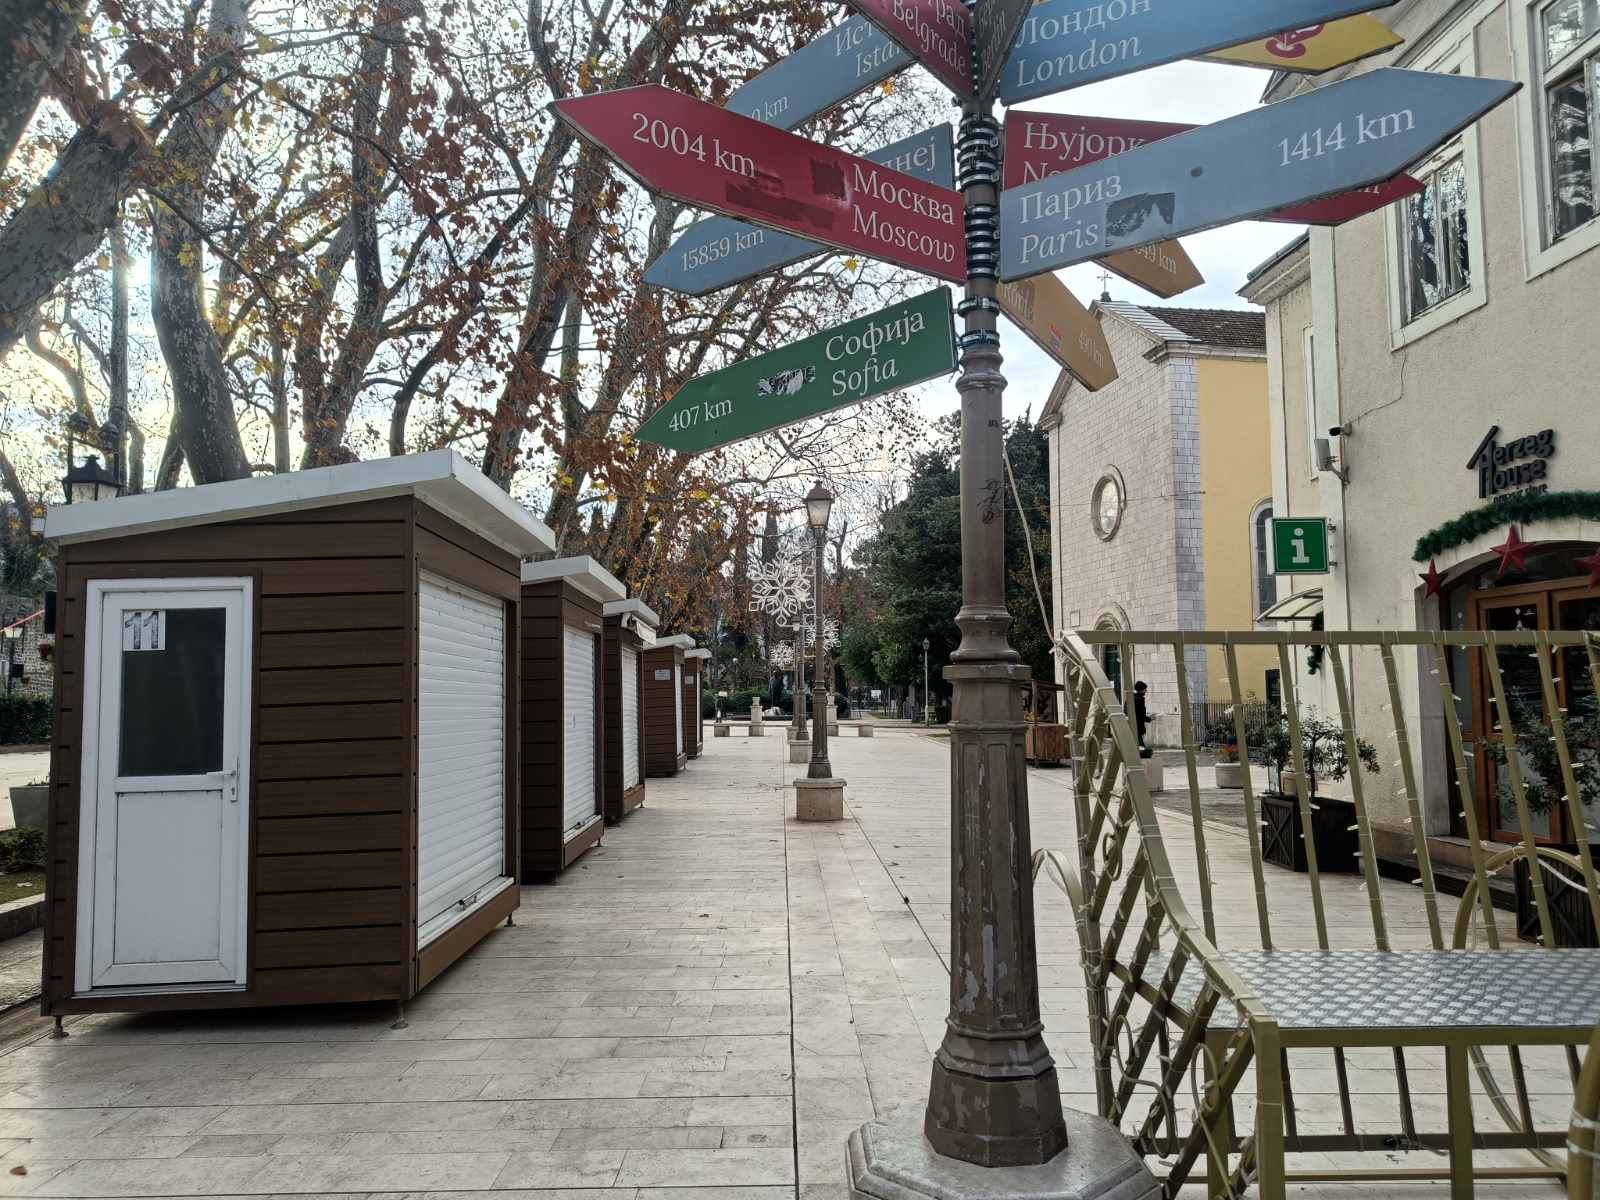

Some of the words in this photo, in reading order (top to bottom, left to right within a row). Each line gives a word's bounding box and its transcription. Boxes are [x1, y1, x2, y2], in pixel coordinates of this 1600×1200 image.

[893, 0, 967, 77] Belgrade
[1015, 0, 1152, 48] Лондон
[856, 40, 900, 79] Ista
[1016, 36, 1143, 87] London
[764, 95, 789, 121] km
[632, 112, 706, 162] 2004
[713, 138, 756, 178] km
[1278, 121, 1346, 167] 1414
[1356, 109, 1415, 145] km
[853, 163, 955, 225] Москва
[1020, 175, 1122, 224] Париз
[682, 236, 731, 272] 15859
[735, 229, 765, 252] km
[852, 204, 955, 263] Moscow
[1019, 220, 1099, 264] Paris
[1159, 246, 1177, 275] km
[825, 310, 925, 361] Софија
[832, 357, 899, 396] Sofia
[668, 405, 700, 432] 407
[703, 400, 733, 421] km
[125, 610, 159, 649] 11
